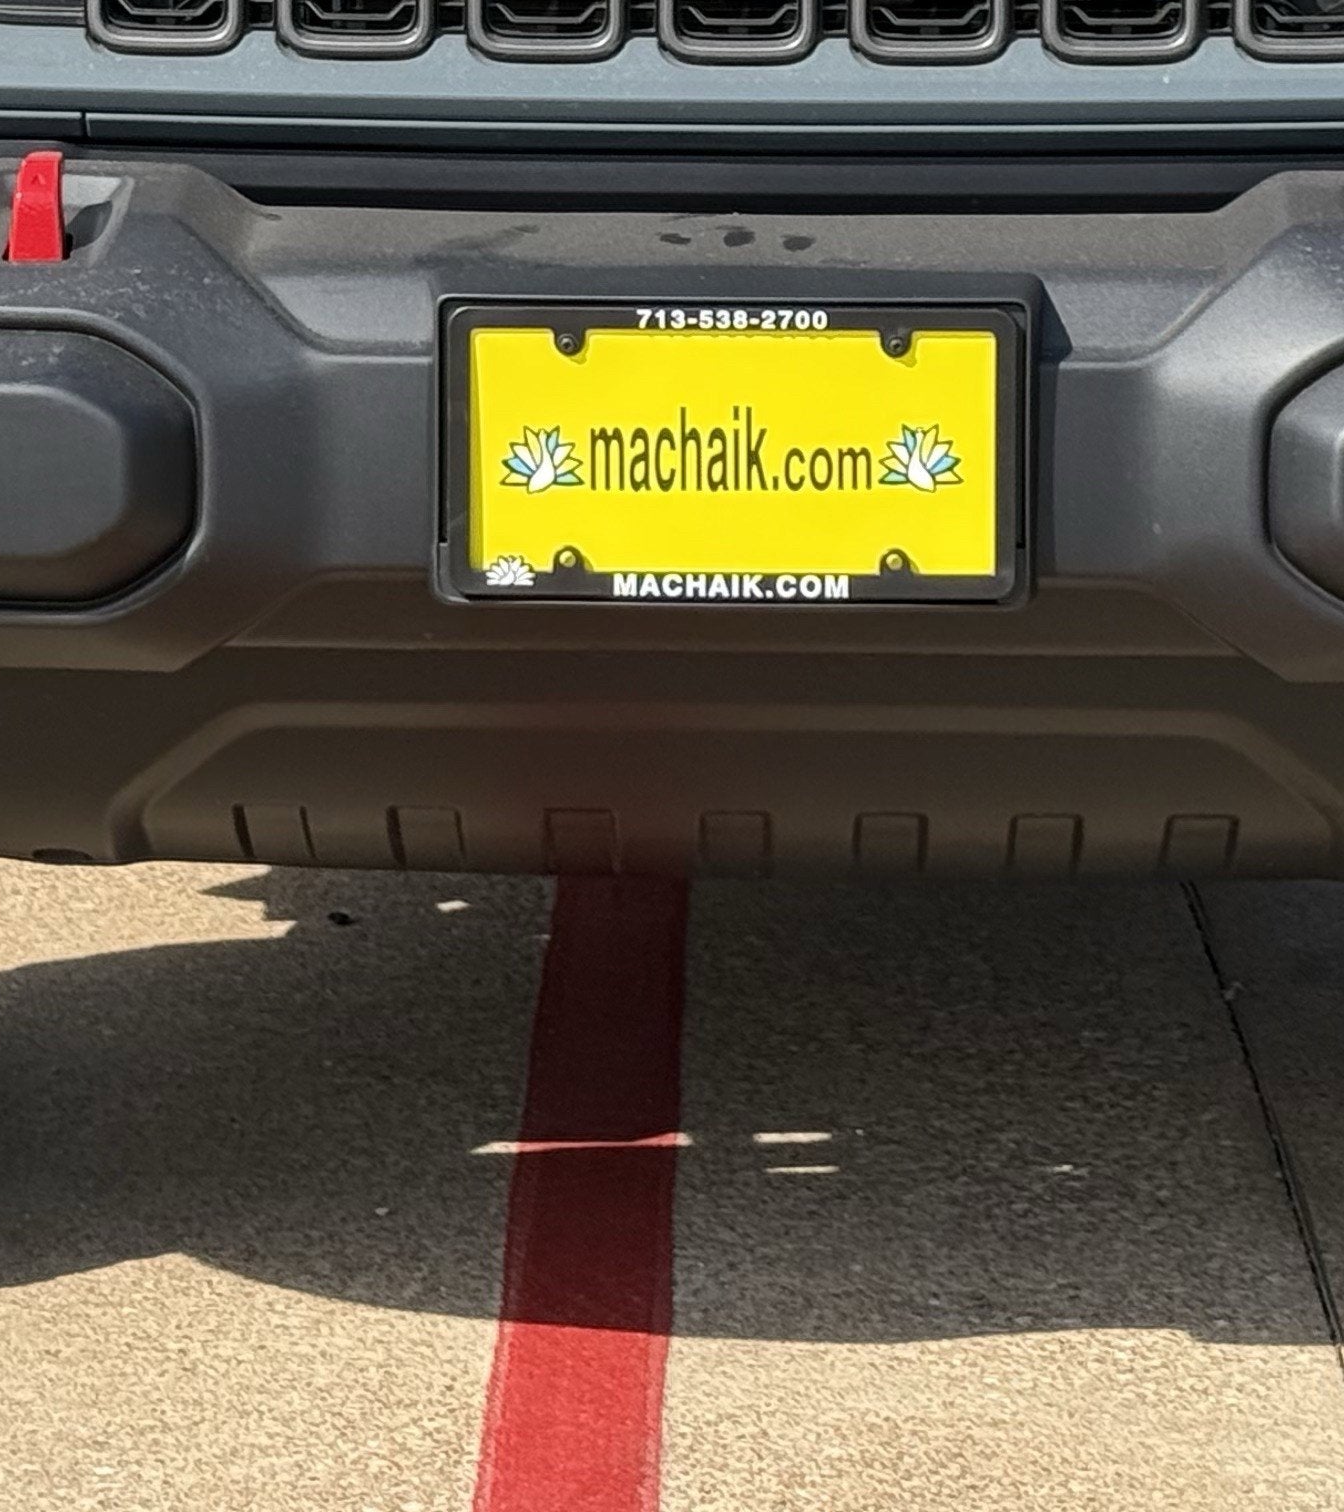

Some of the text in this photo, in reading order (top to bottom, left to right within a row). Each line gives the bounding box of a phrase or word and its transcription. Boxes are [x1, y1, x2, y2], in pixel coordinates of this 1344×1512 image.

[636, 308, 829, 330] 713-538-2700
[590, 405, 873, 492] machaik.com
[612, 572, 850, 599] MACHAIK.COM
